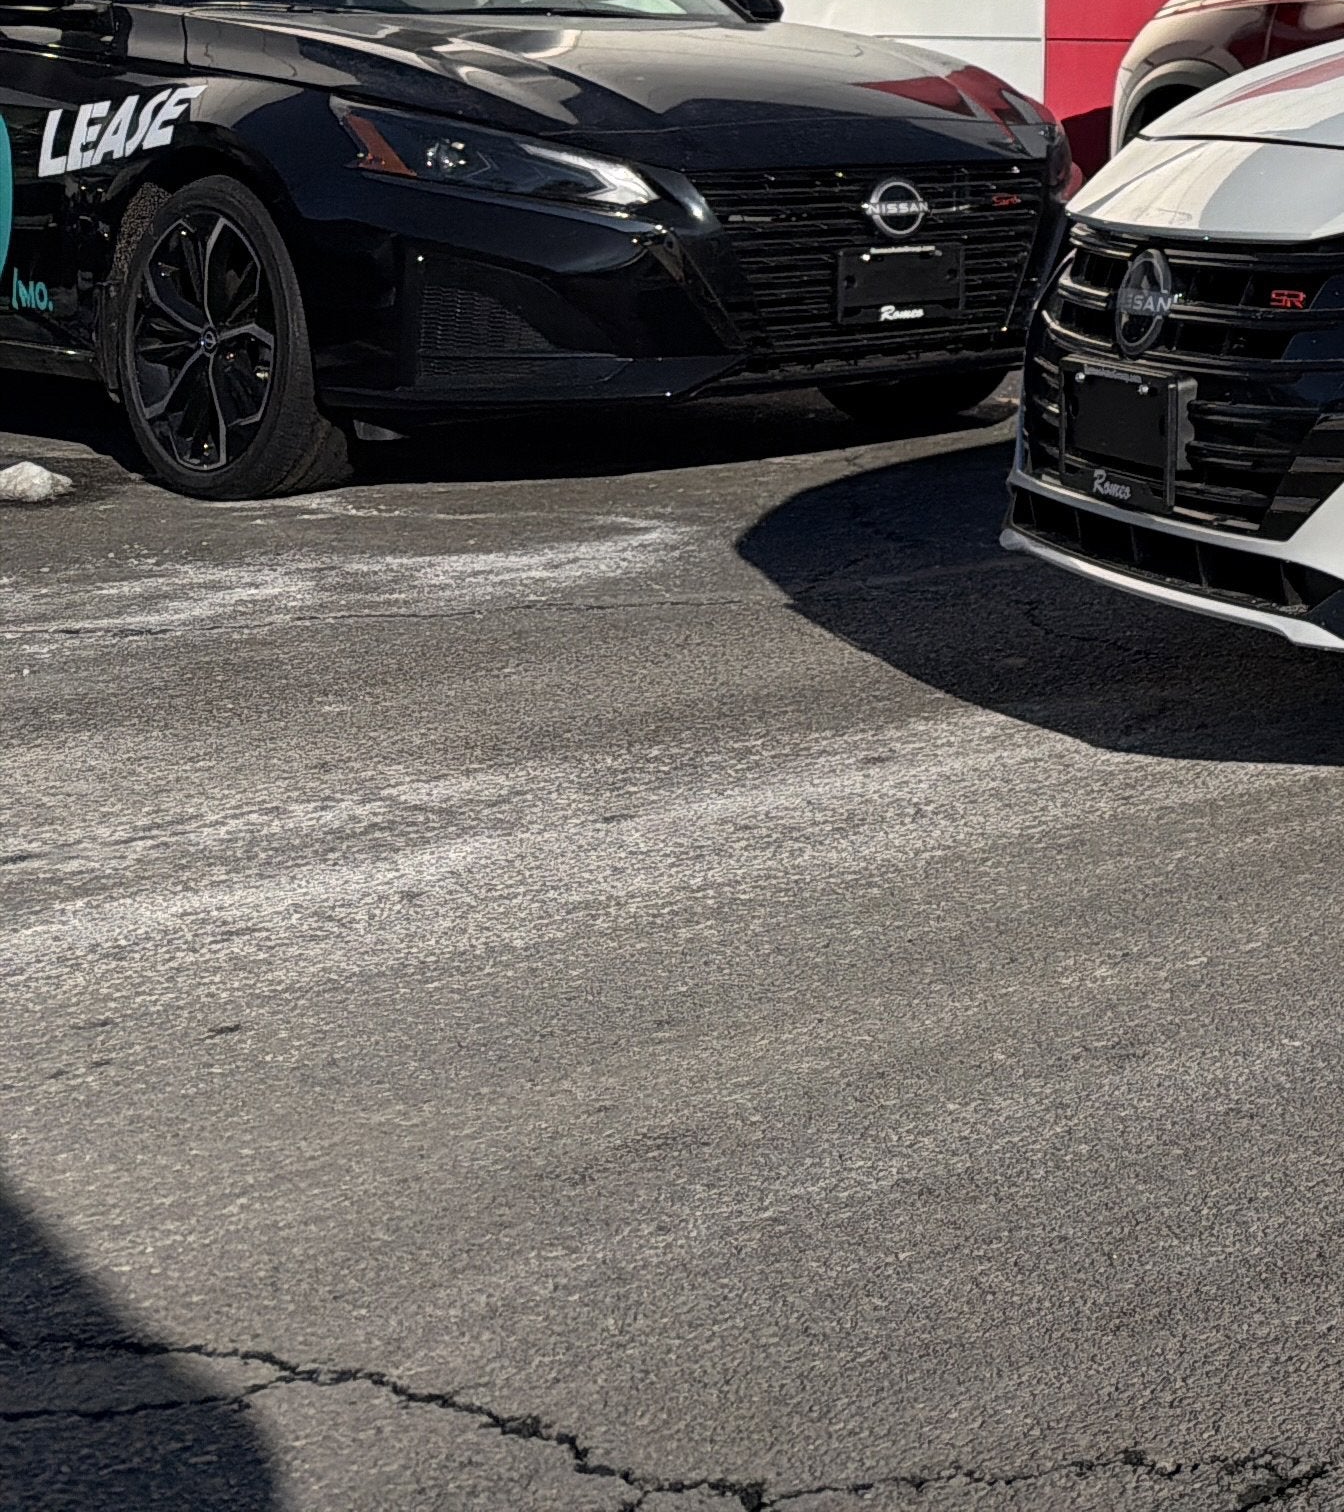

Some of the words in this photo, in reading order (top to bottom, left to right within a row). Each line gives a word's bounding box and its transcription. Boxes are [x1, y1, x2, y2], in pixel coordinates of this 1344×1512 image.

[38, 85, 208, 178] LEASE
[867, 201, 929, 215] NISSAN
[1270, 289, 1306, 308] SR
[880, 304, 925, 322] Romeo
